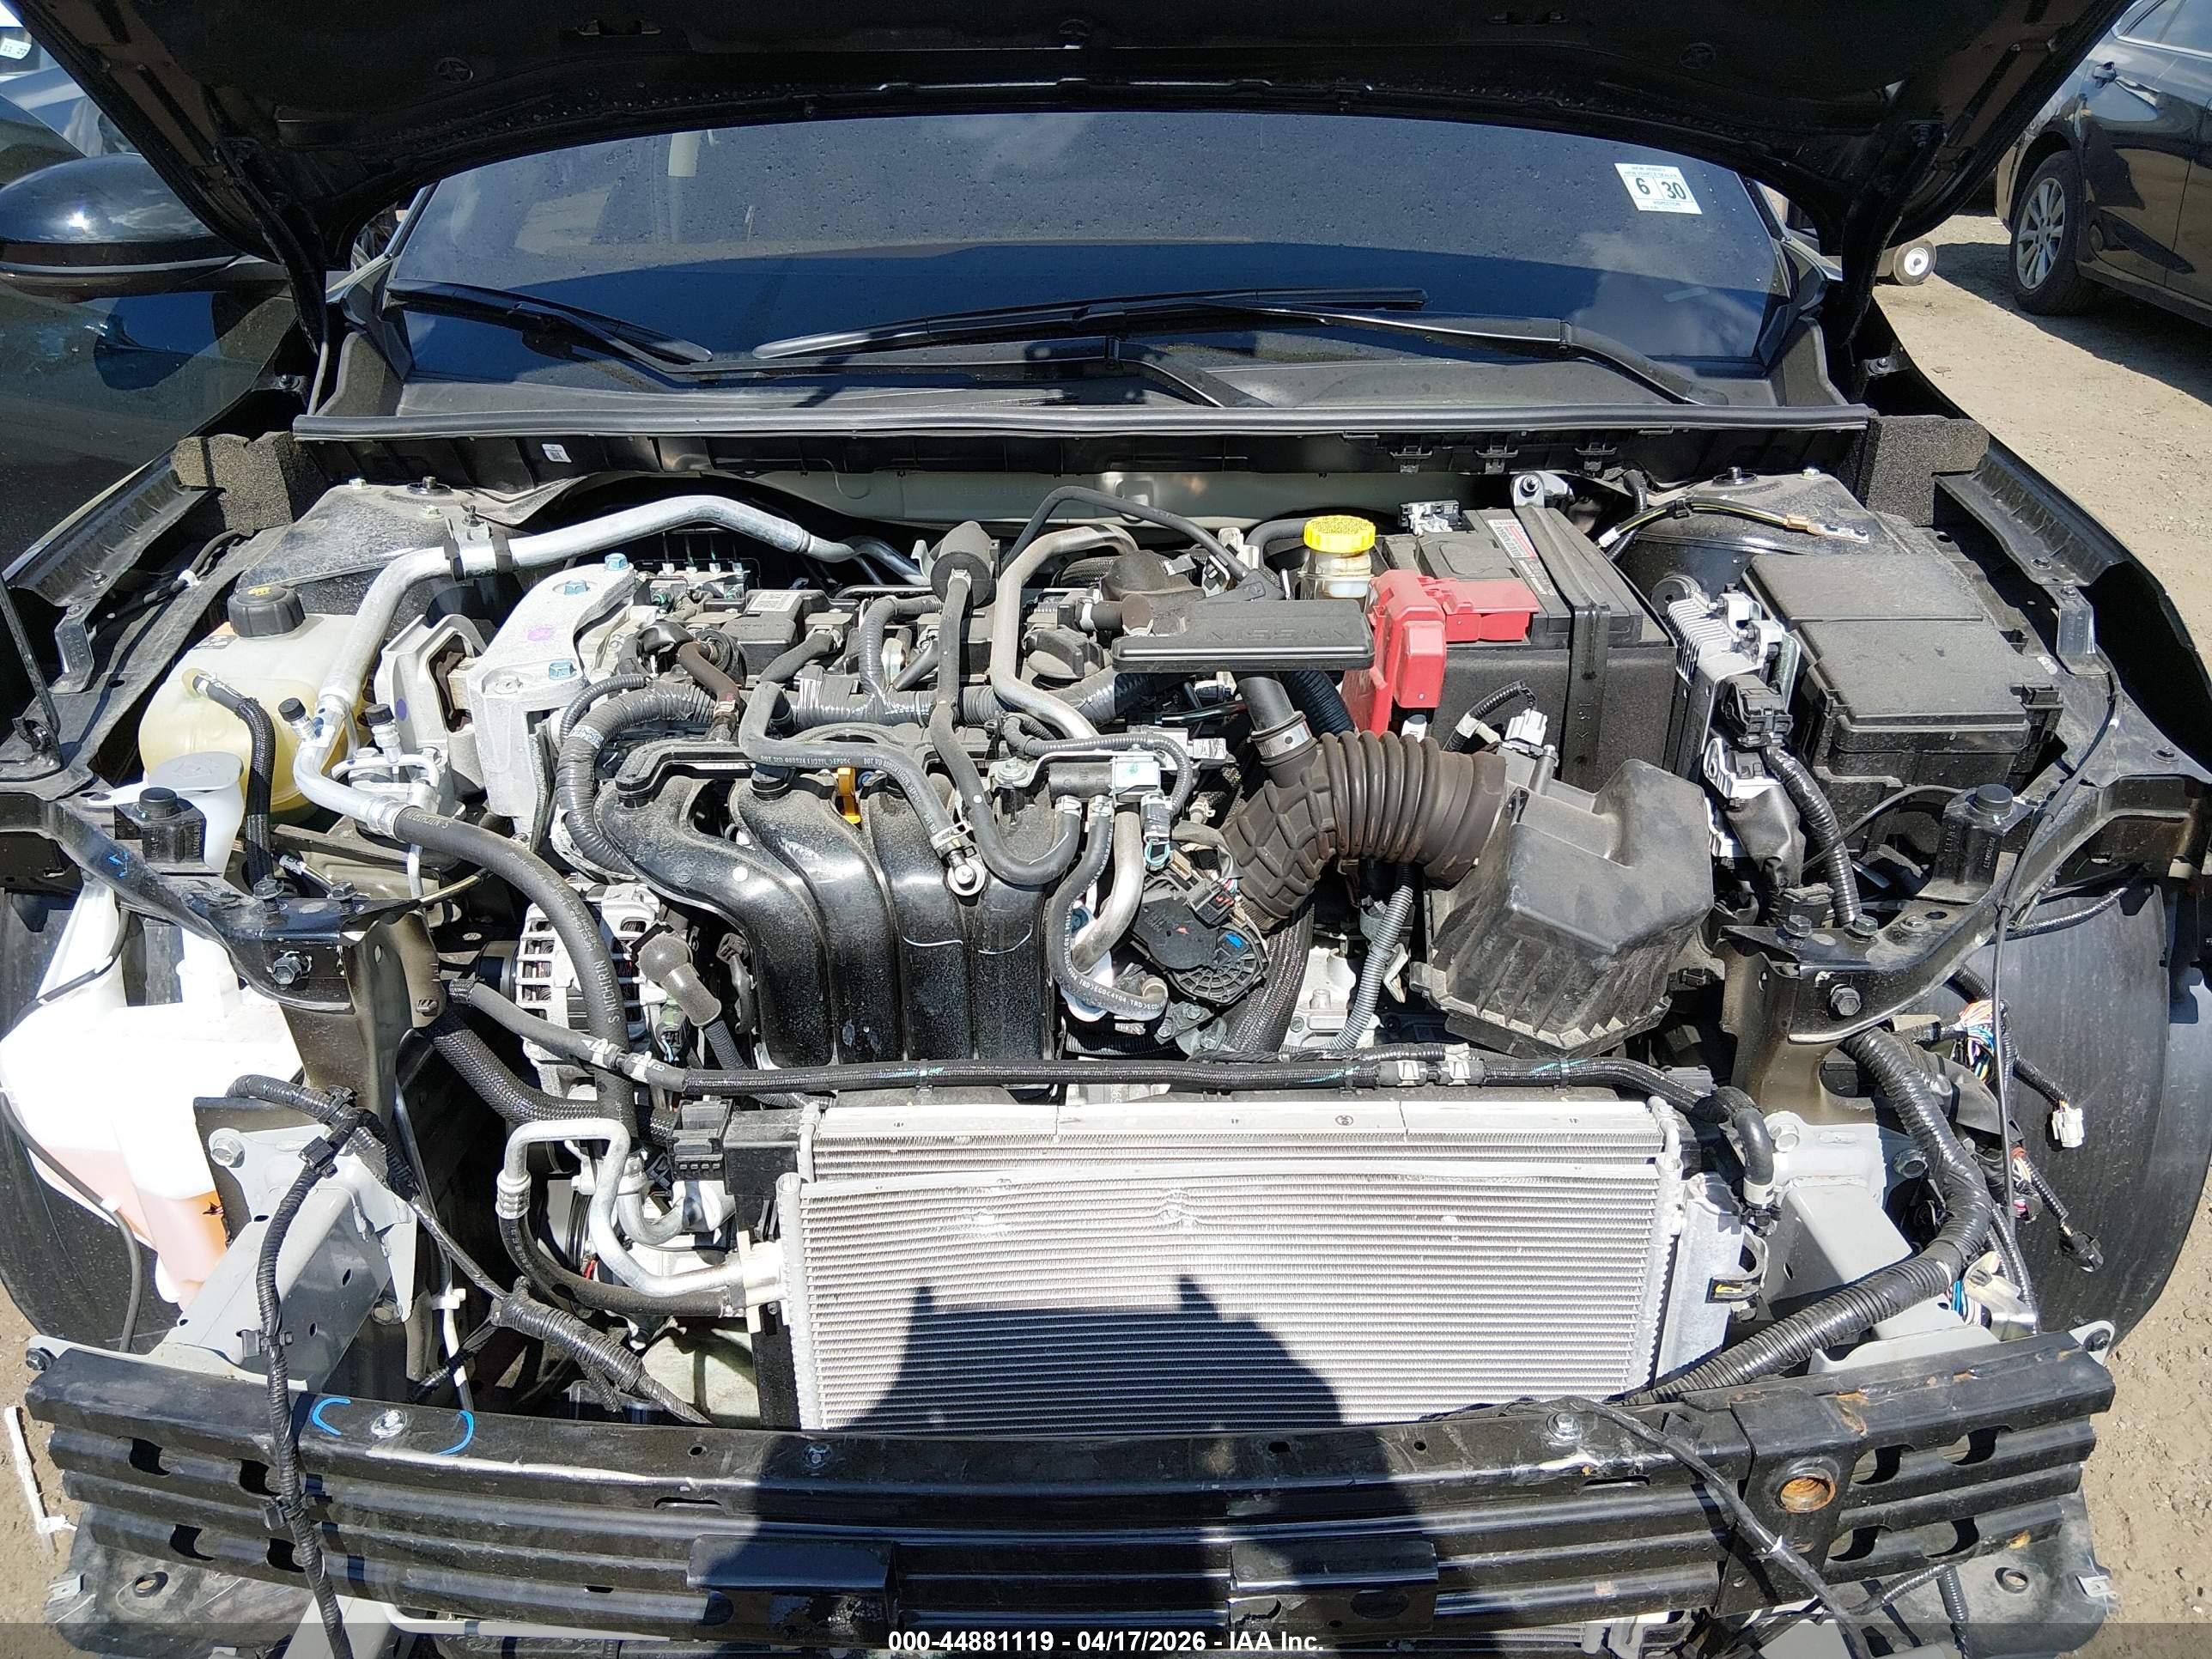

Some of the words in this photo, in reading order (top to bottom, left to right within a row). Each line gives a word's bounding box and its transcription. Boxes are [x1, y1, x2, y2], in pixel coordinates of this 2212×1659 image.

[1635, 177, 1650, 195] 6
[1661, 181, 1686, 200] 30
[594, 960, 619, 1011] NICHIRIN
